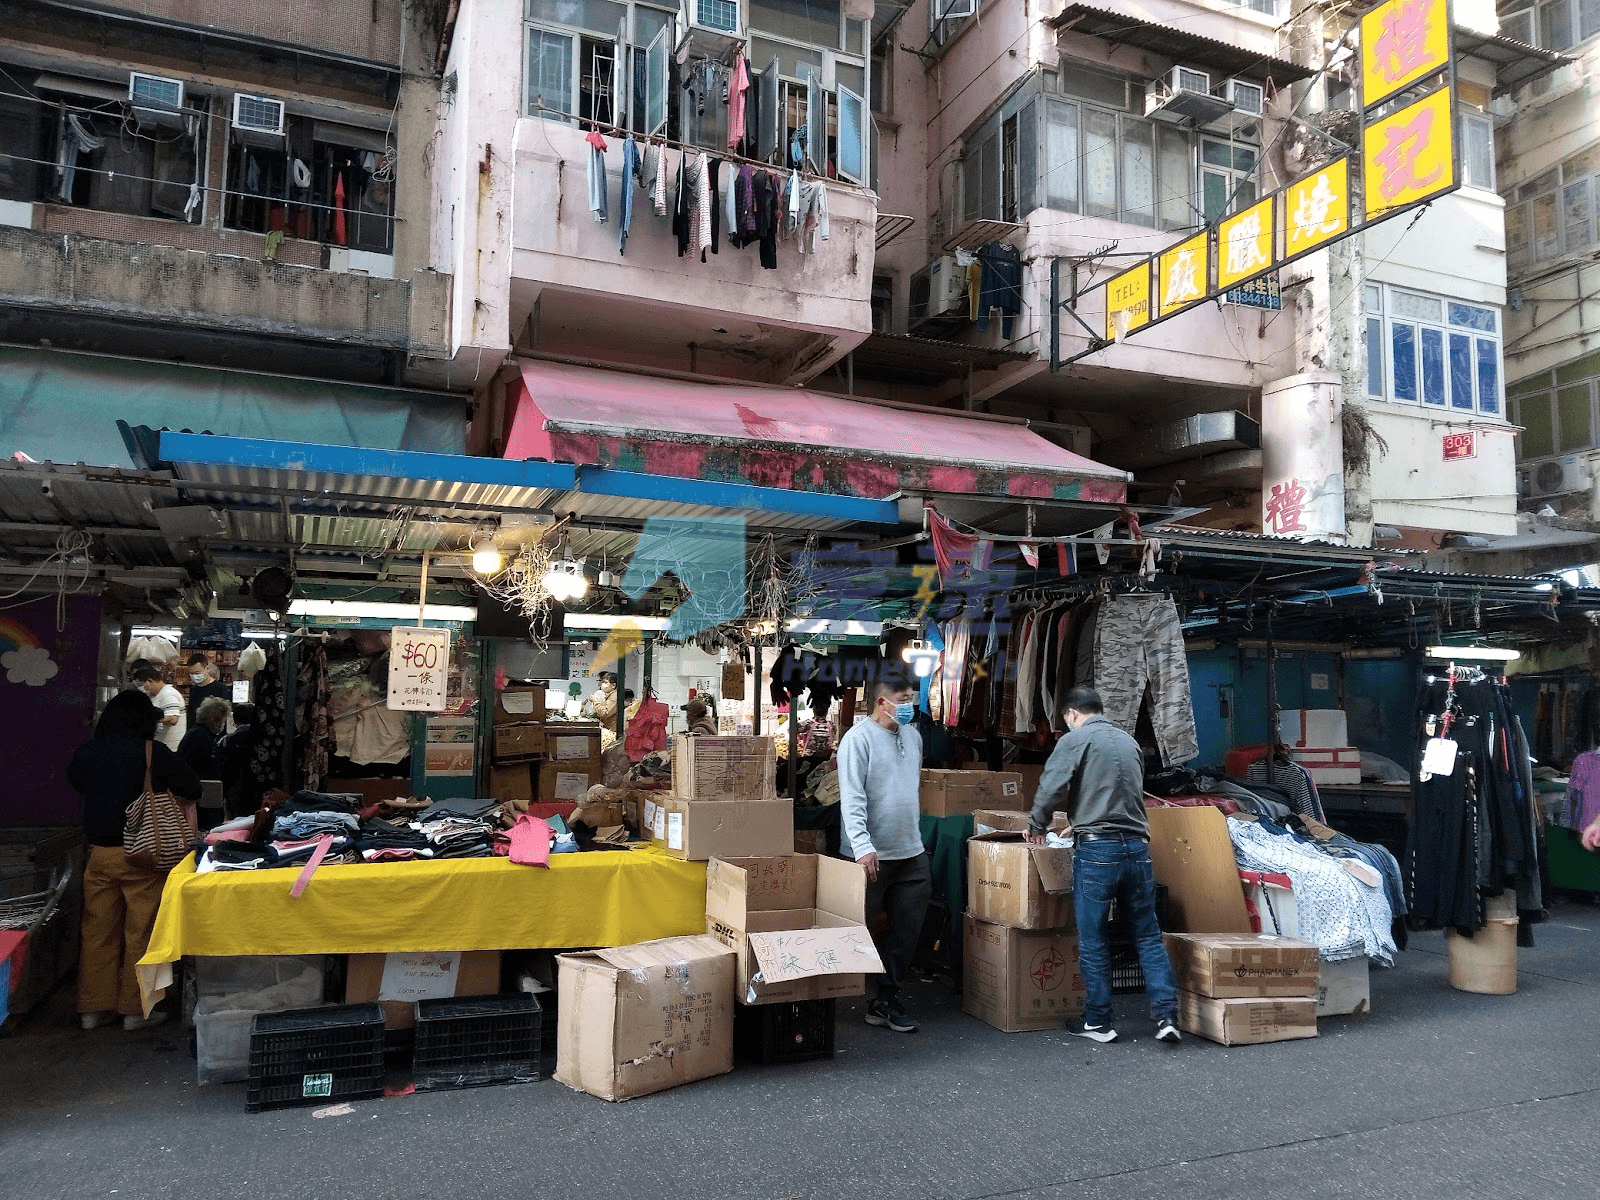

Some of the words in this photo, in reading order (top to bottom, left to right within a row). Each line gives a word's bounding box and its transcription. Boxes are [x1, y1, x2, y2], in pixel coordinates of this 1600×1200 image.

[1445, 435, 1471, 449] 303
[1265, 478, 1307, 534] 禮
[401, 640, 438, 669] $60
[407, 671, 434, 685] 一條
[715, 922, 735, 940] DHL
[1248, 967, 1299, 977] PHARMANEX
